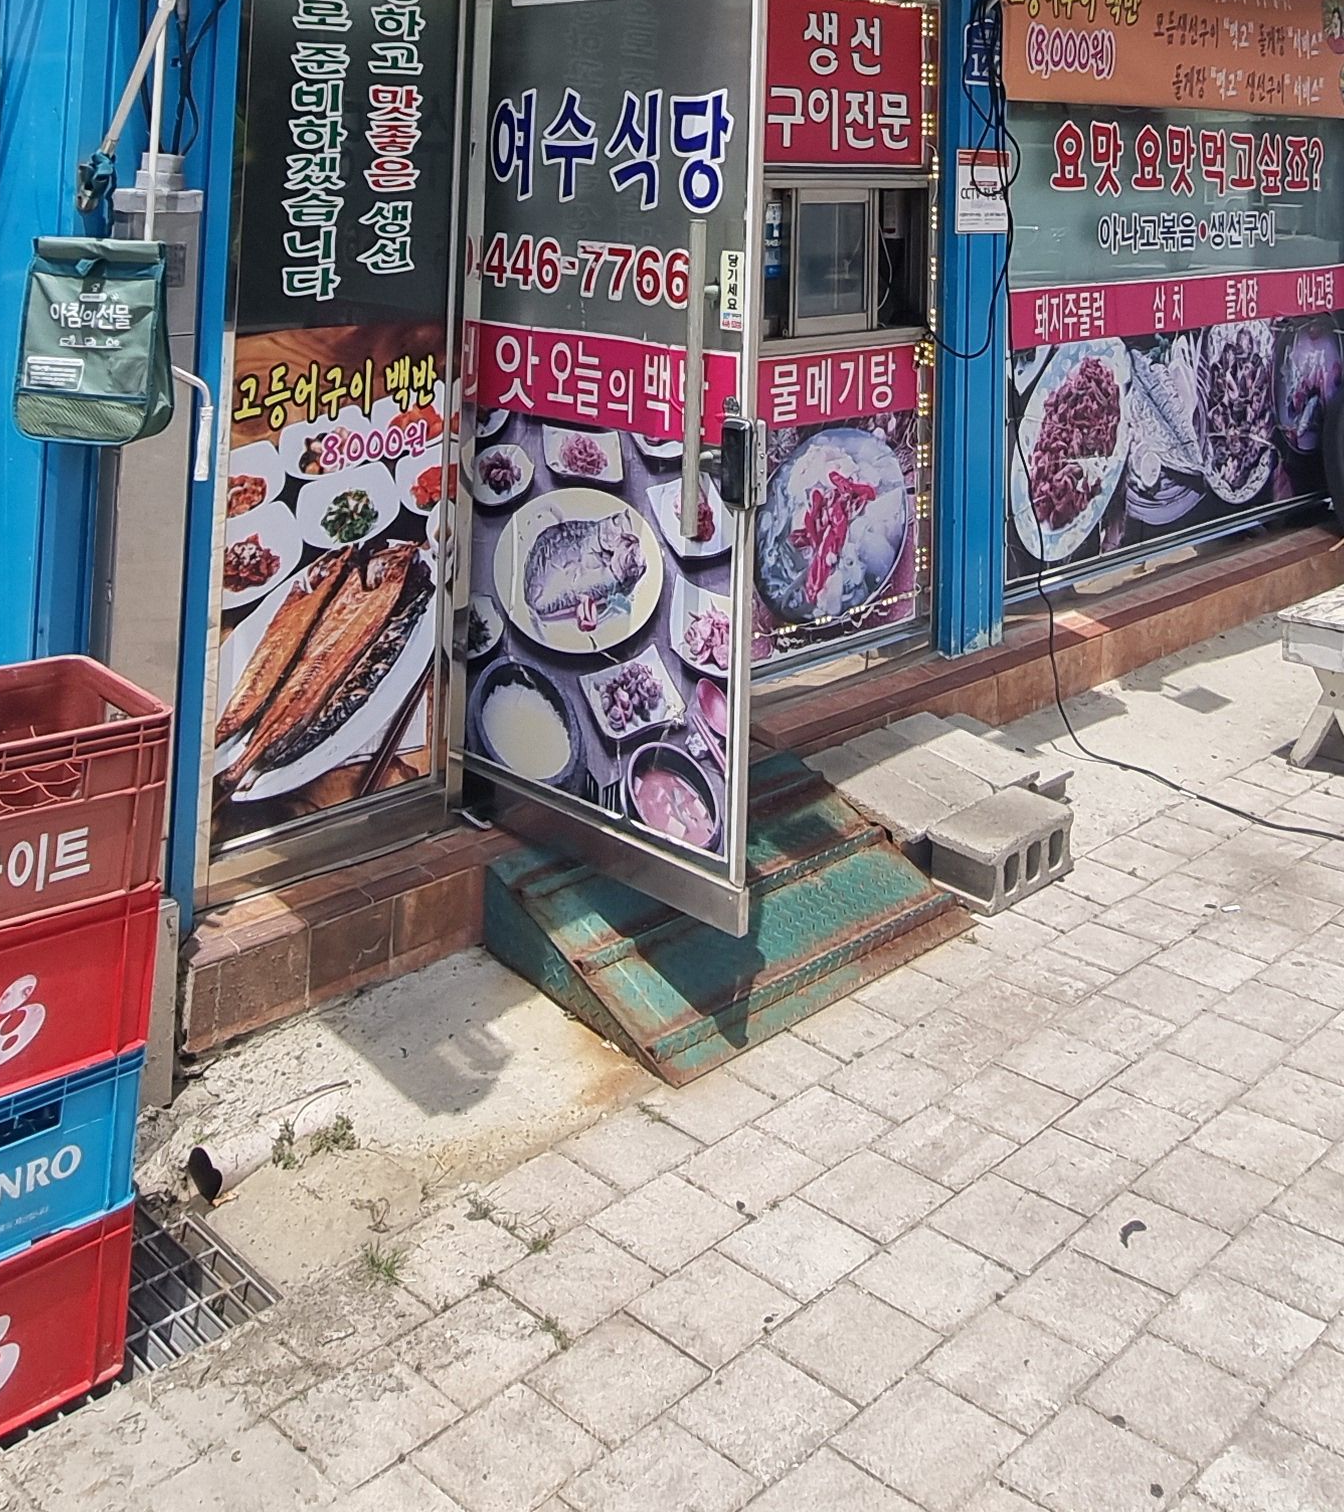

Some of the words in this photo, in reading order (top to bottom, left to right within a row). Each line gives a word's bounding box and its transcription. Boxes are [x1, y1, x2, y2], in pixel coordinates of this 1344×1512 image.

[803, 11, 883, 76] 생선
[363, 84, 423, 192] 맛좋은
[490, 87, 735, 214] 여수식당
[767, 87, 912, 151] 구이전문
[281, 41, 351, 302] 준비하겠습니다
[356, 200, 415, 275] 생선
[483, 231, 691, 310] 446-7766
[726, 253, 739, 311] 당기세요
[1034, 289, 1105, 341] 돼지주물럭
[1224, 277, 1259, 320] 돌게장
[1296, 271, 1334, 310] 아나고탕
[232, 357, 374, 428] 고등어구이
[385, 353, 438, 410] 백반
[496, 334, 541, 409] 앗
[547, 341, 635, 425] 오늘의
[769, 356, 897, 423] 물메기탕
[319, 419, 430, 472] 8,000원
